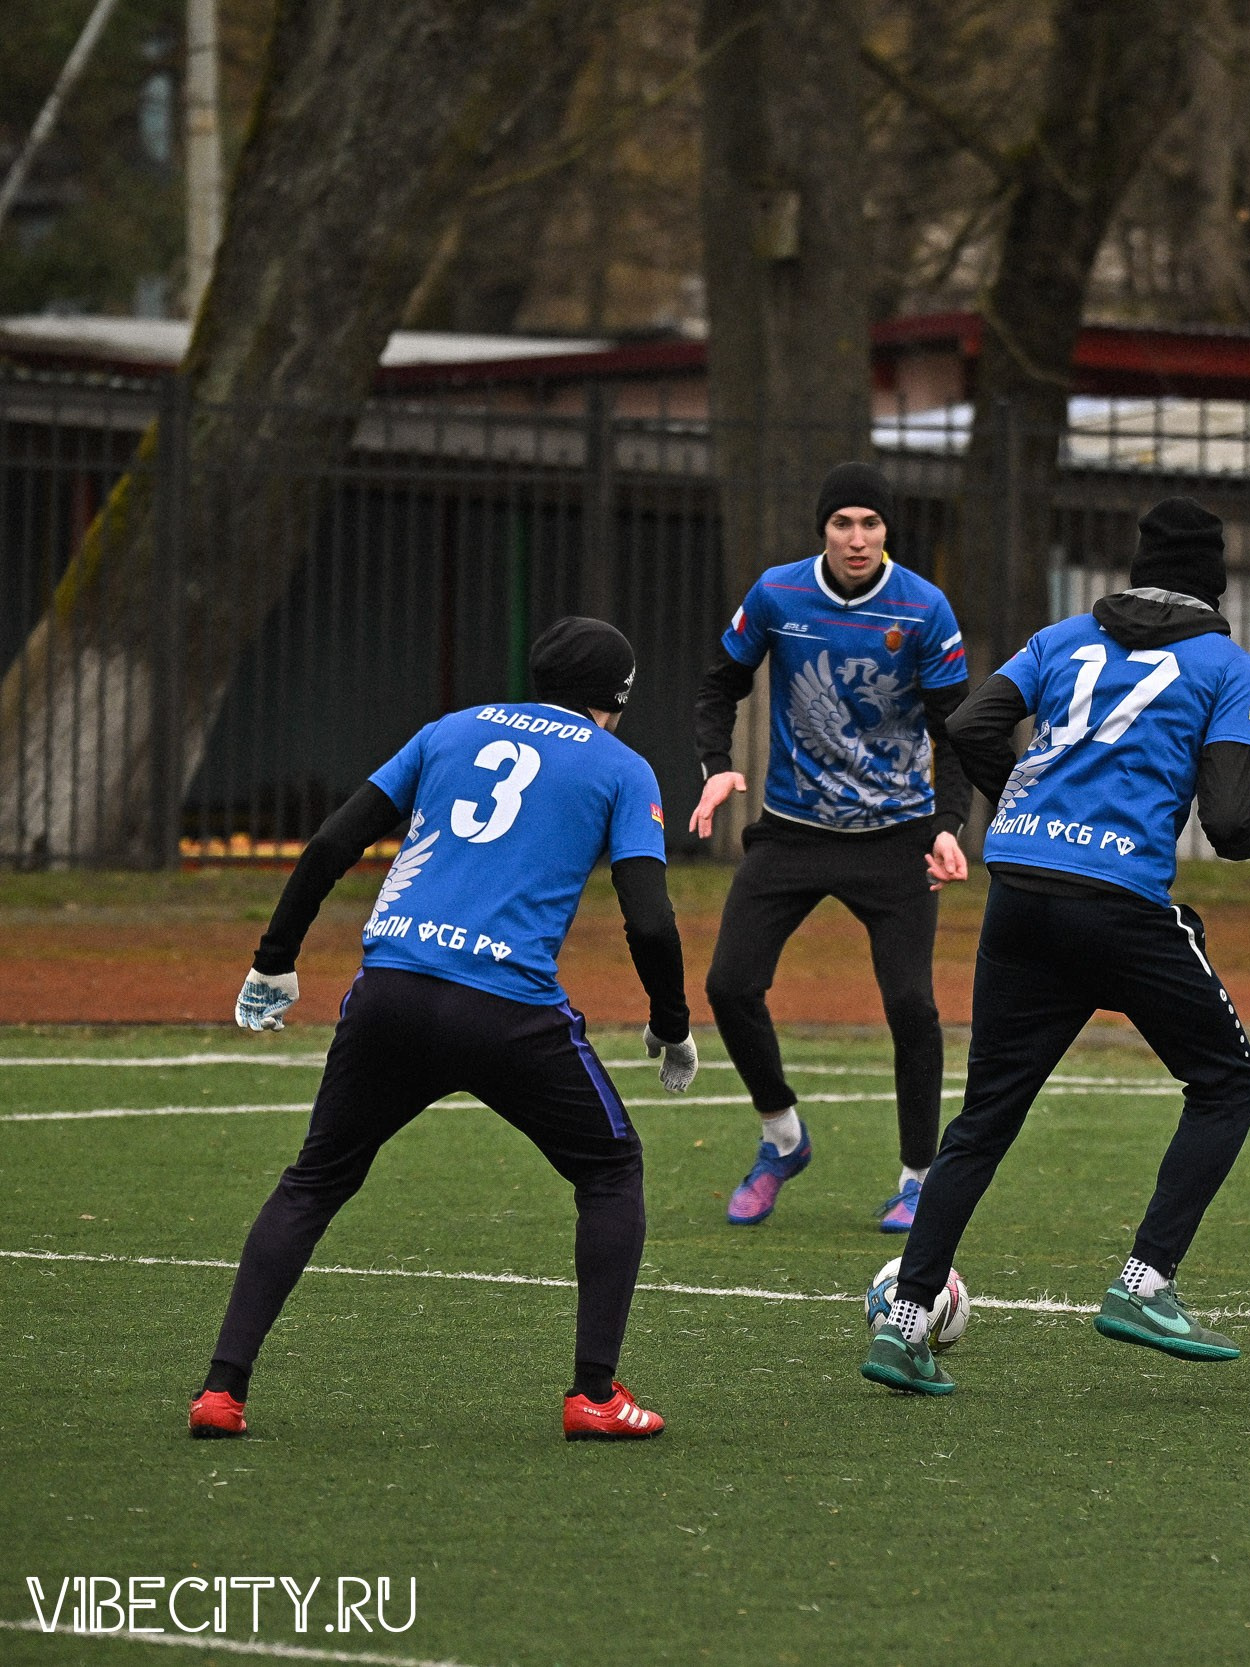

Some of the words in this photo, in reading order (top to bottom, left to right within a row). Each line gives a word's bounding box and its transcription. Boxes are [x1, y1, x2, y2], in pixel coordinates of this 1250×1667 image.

[1051, 643, 1181, 745] 17
[475, 706, 594, 744] ВЫБОРОВ
[450, 739, 541, 844] 3
[1046, 819, 1094, 845] ФСБ
[1099, 830, 1136, 857] РФ
[417, 920, 468, 950] ФСБ
[472, 933, 513, 962] РФ
[583, 1407, 601, 1417] COPA
